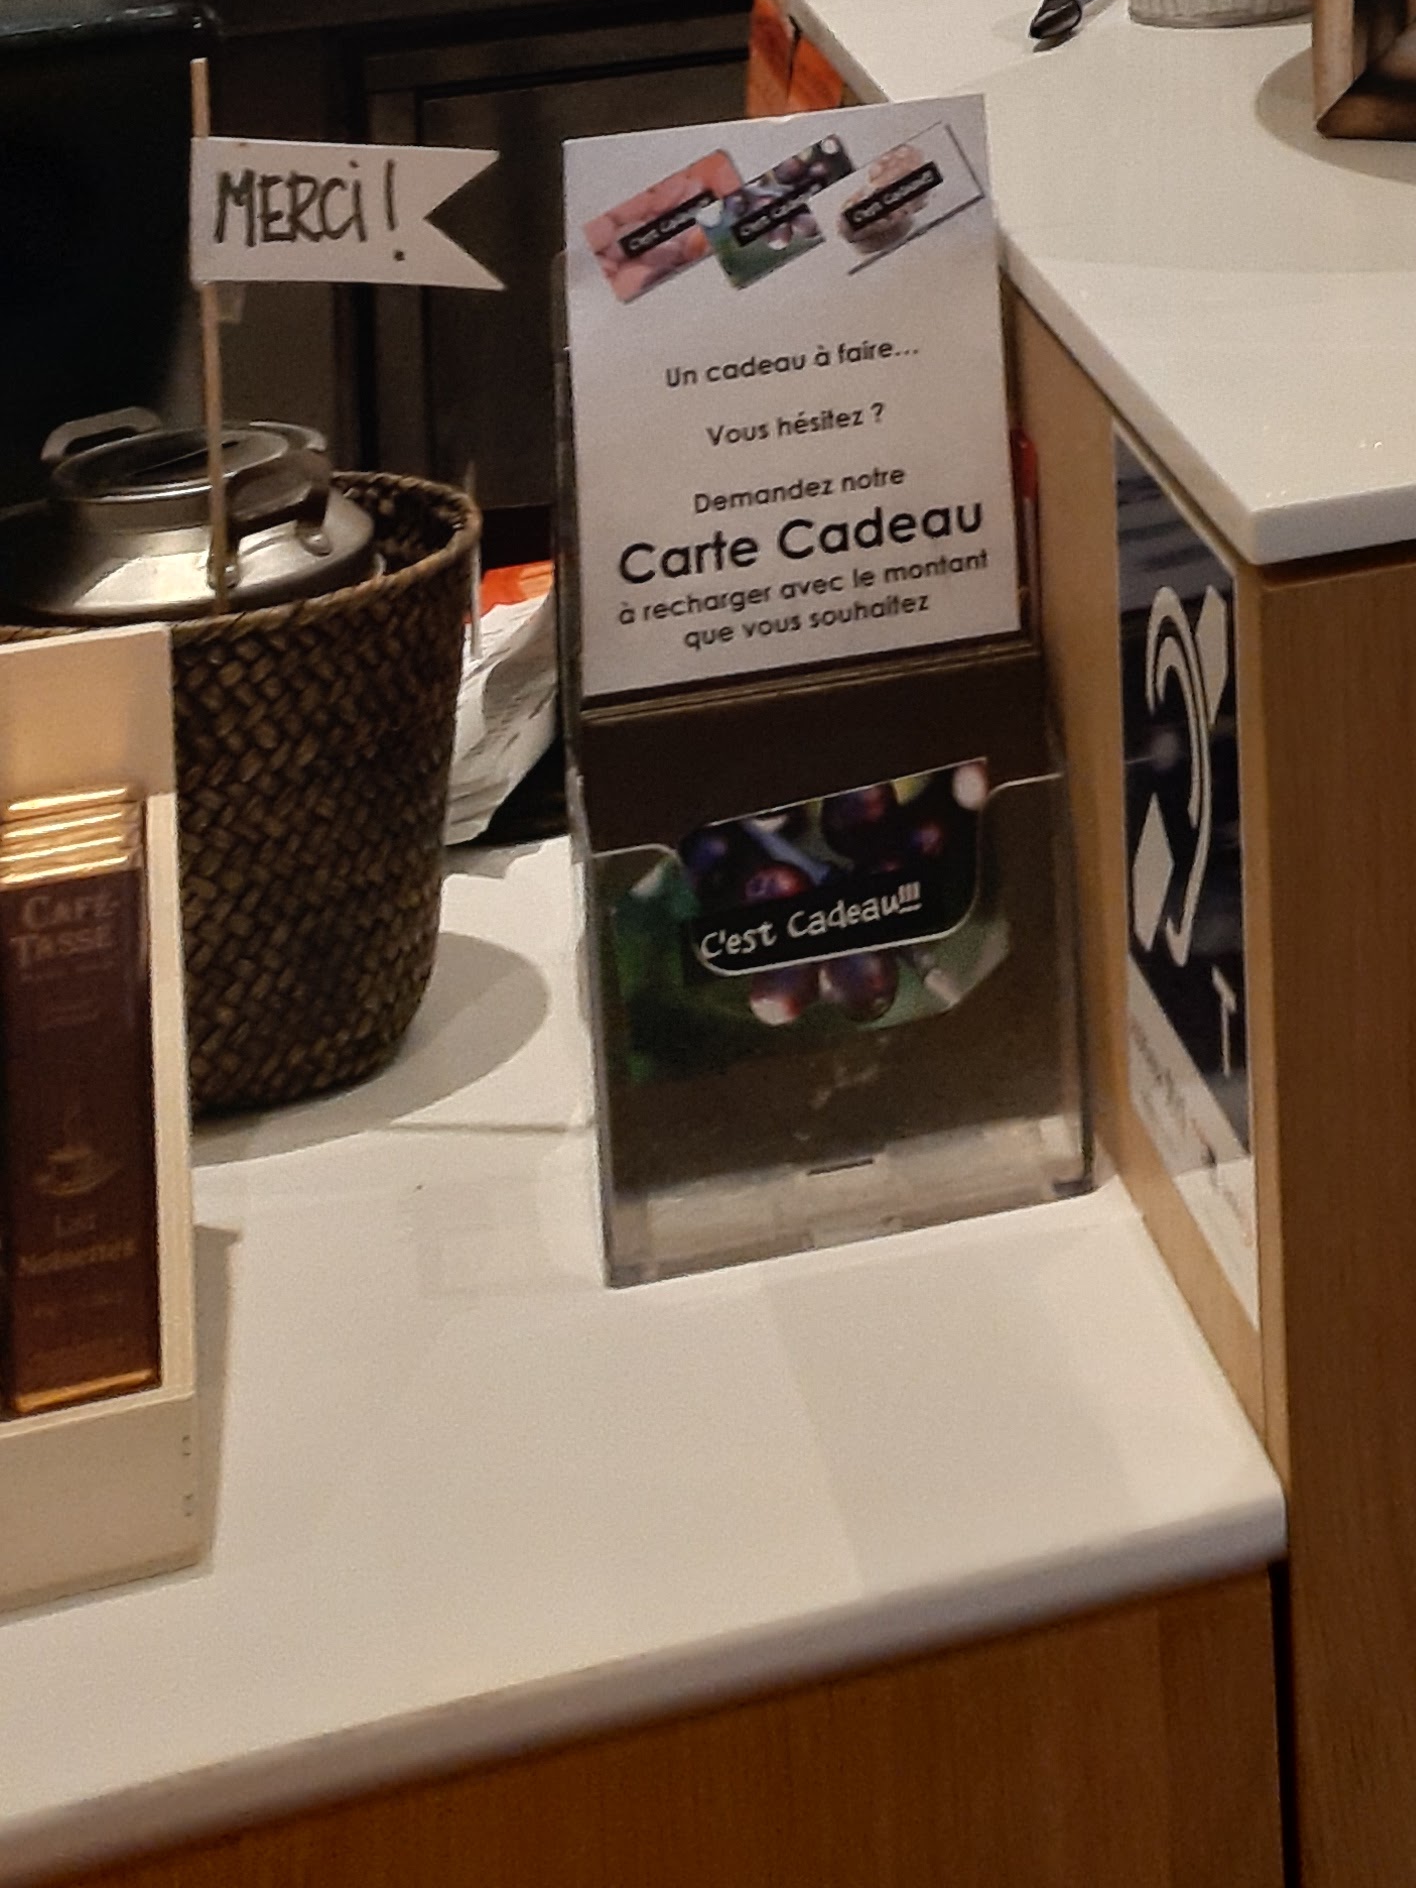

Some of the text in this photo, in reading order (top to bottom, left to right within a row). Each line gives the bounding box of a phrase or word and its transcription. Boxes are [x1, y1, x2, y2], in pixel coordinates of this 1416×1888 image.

[666, 367, 697, 387] Un
[706, 354, 806, 382] cadeau
[814, 345, 830, 367] à
[706, 423, 769, 446] Vous
[777, 409, 863, 436] hésitez
[694, 467, 905, 514] Demandez notre
[618, 503, 982, 584] Carte Cadeau
[618, 548, 987, 625] à recharger avec le montant
[684, 595, 928, 651] que vous souhaitez
